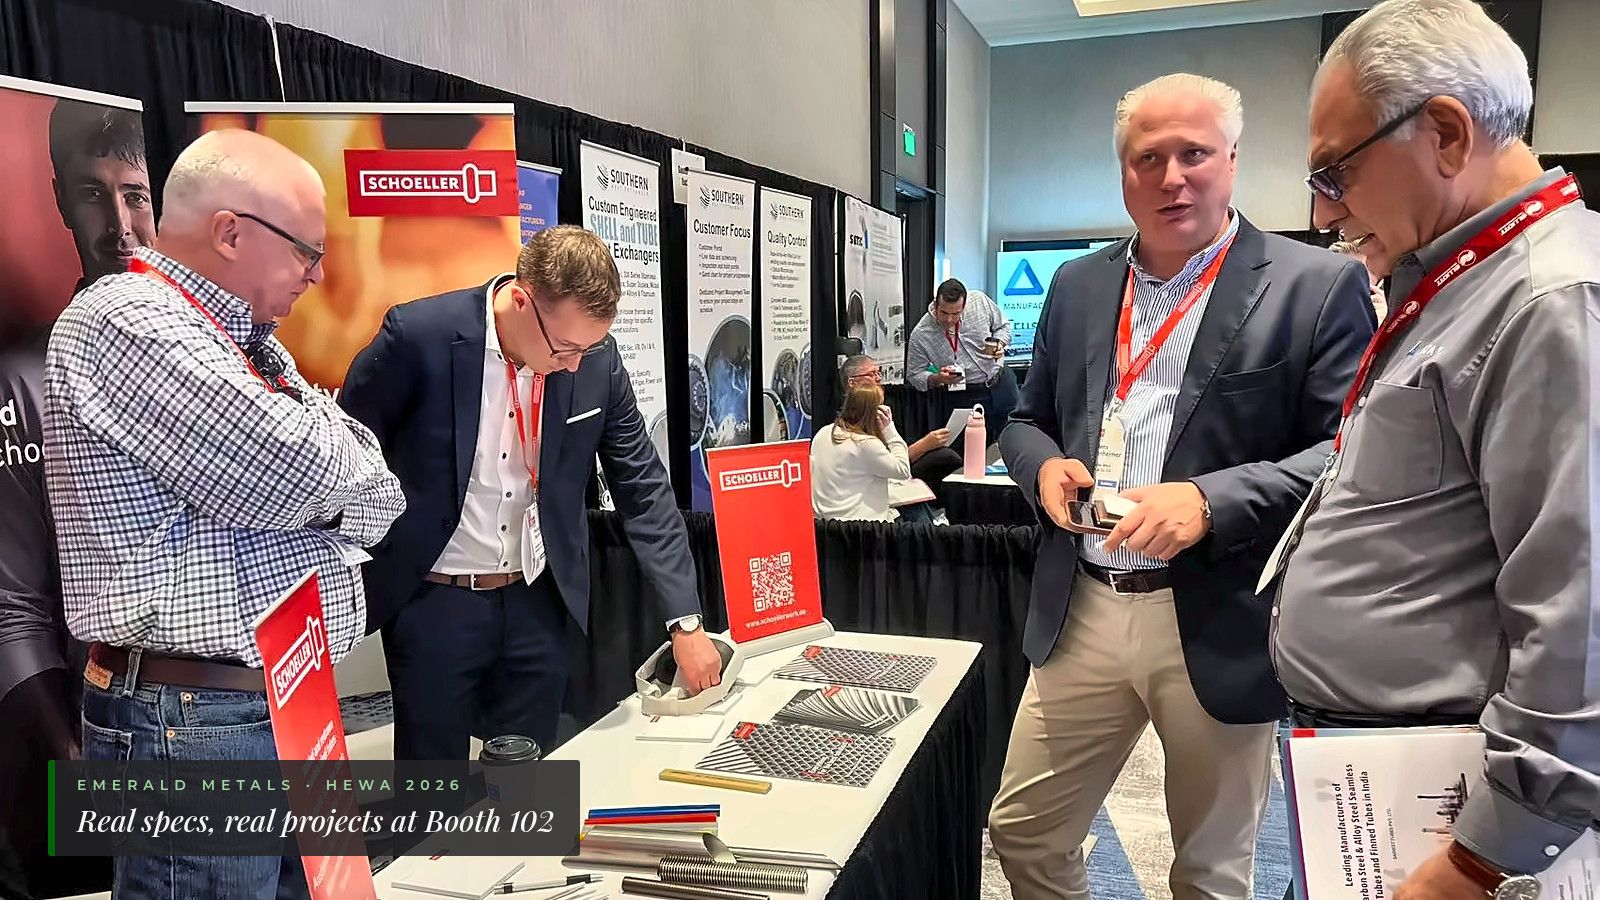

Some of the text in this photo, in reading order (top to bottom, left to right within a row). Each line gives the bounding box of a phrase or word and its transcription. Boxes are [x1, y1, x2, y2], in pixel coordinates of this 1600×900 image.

[368, 177, 460, 190] SCHOELLER
[610, 169, 649, 191] SOUTHERN
[711, 189, 744, 206] SOUTHERN
[588, 196, 657, 222] Custom Engineered
[779, 204, 804, 219] SOUTHERN
[590, 214, 658, 246] SHELL and TUBE
[693, 218, 751, 239] Customer Focus
[767, 230, 808, 248] Quality Control
[614, 242, 659, 265] Exchangers
[1003, 302, 1043, 310] MANUFAC
[0, 398, 17, 427] d
[724, 469, 781, 486] SCHOELLER
[275, 640, 312, 695] SCHOELLER
[1345, 763, 1357, 801] Seamless
[1348, 802, 1360, 823] Steel
[1331, 783, 1354, 887] Leading Manufacturers of
[1352, 824, 1363, 845] Alloy
[1359, 771, 1384, 899] Tubes and Finned Tubes in India
[1355, 855, 1367, 876] Steel
[1360, 877, 1370, 900] arbon
